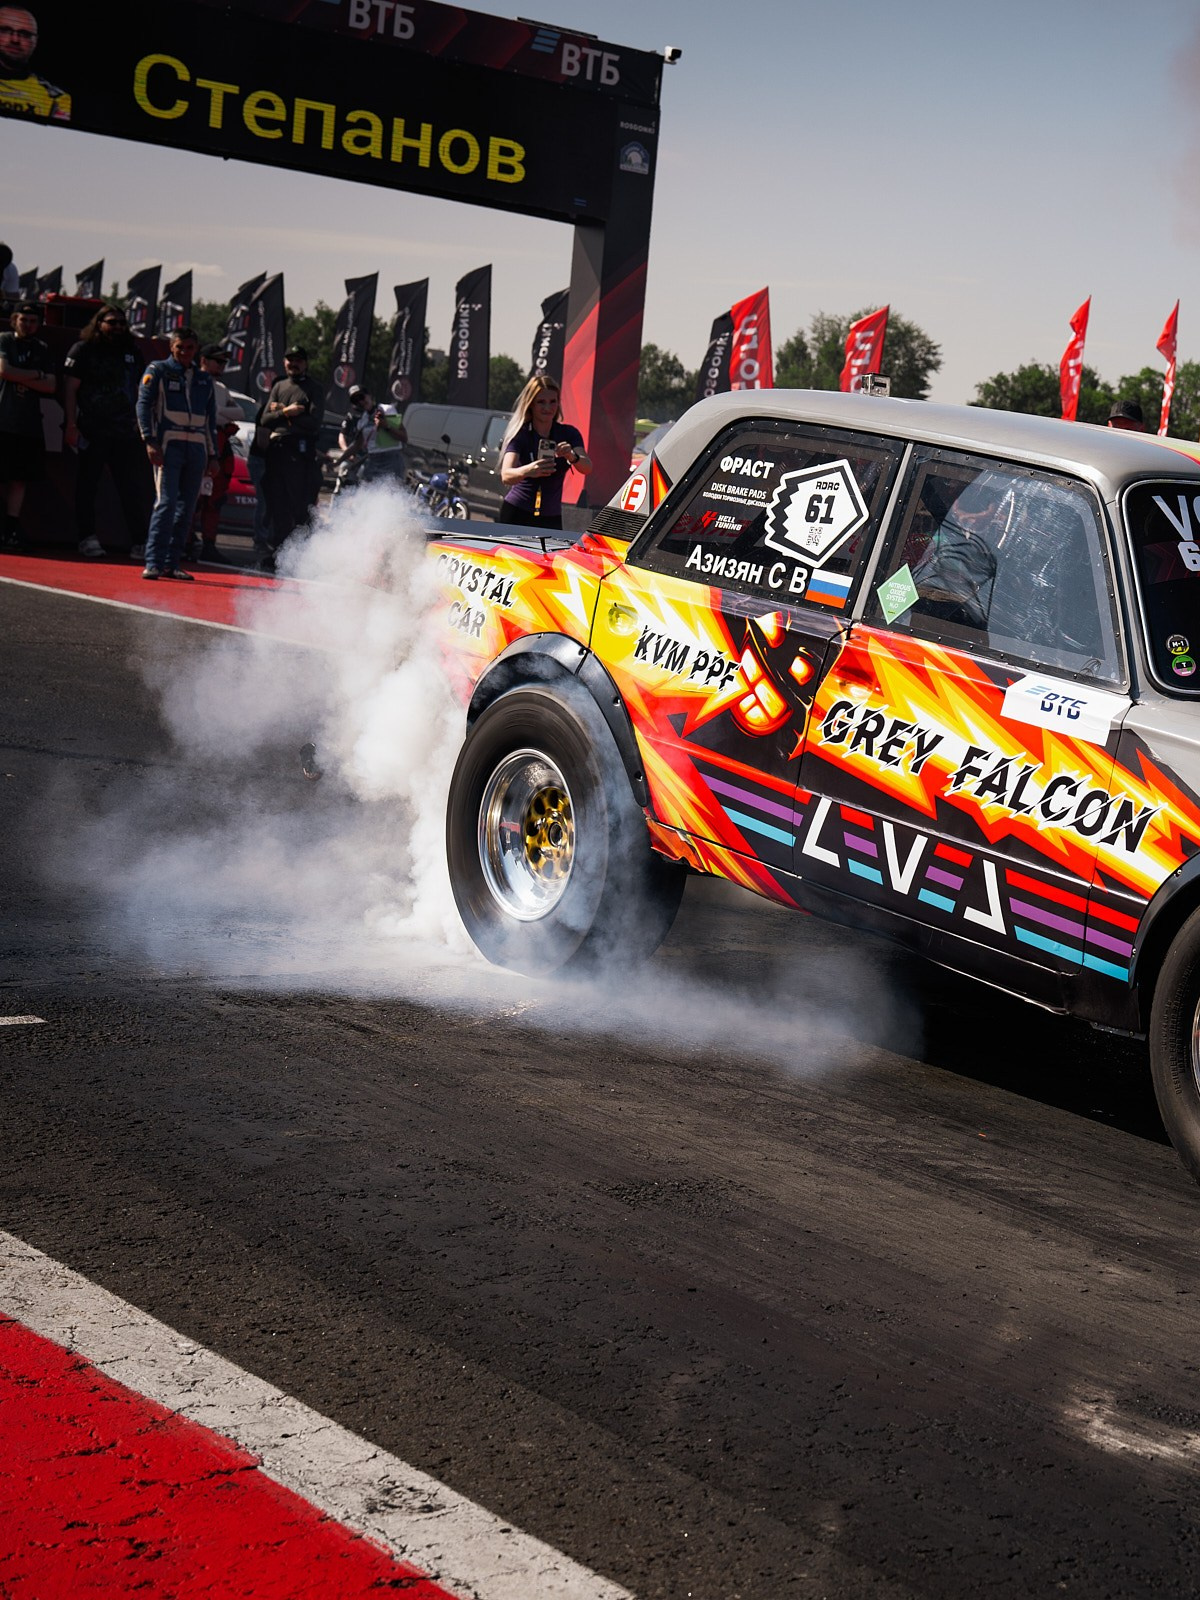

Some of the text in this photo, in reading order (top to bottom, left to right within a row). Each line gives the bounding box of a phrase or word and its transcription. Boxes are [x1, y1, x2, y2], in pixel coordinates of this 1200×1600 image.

[348, 0, 416, 40] ВТБ
[561, 43, 620, 86] ВТБ
[134, 53, 526, 184] Степанов
[719, 456, 775, 480] ФРАСТ
[624, 479, 643, 511] E
[711, 482, 767, 500] DISK BRAKE PADS
[815, 481, 840, 491] RDRC
[717, 515, 736, 523] HELL
[804, 493, 836, 525] 61
[714, 521, 742, 531] TUNING
[437, 553, 516, 608] CRYSTAL
[768, 562, 787, 589] С
[788, 566, 808, 594] В
[449, 602, 486, 640] CAR
[633, 626, 741, 693] KVM PPF
[1040, 692, 1088, 721] ВТБ
[819, 699, 1167, 853] GREY FALCON
